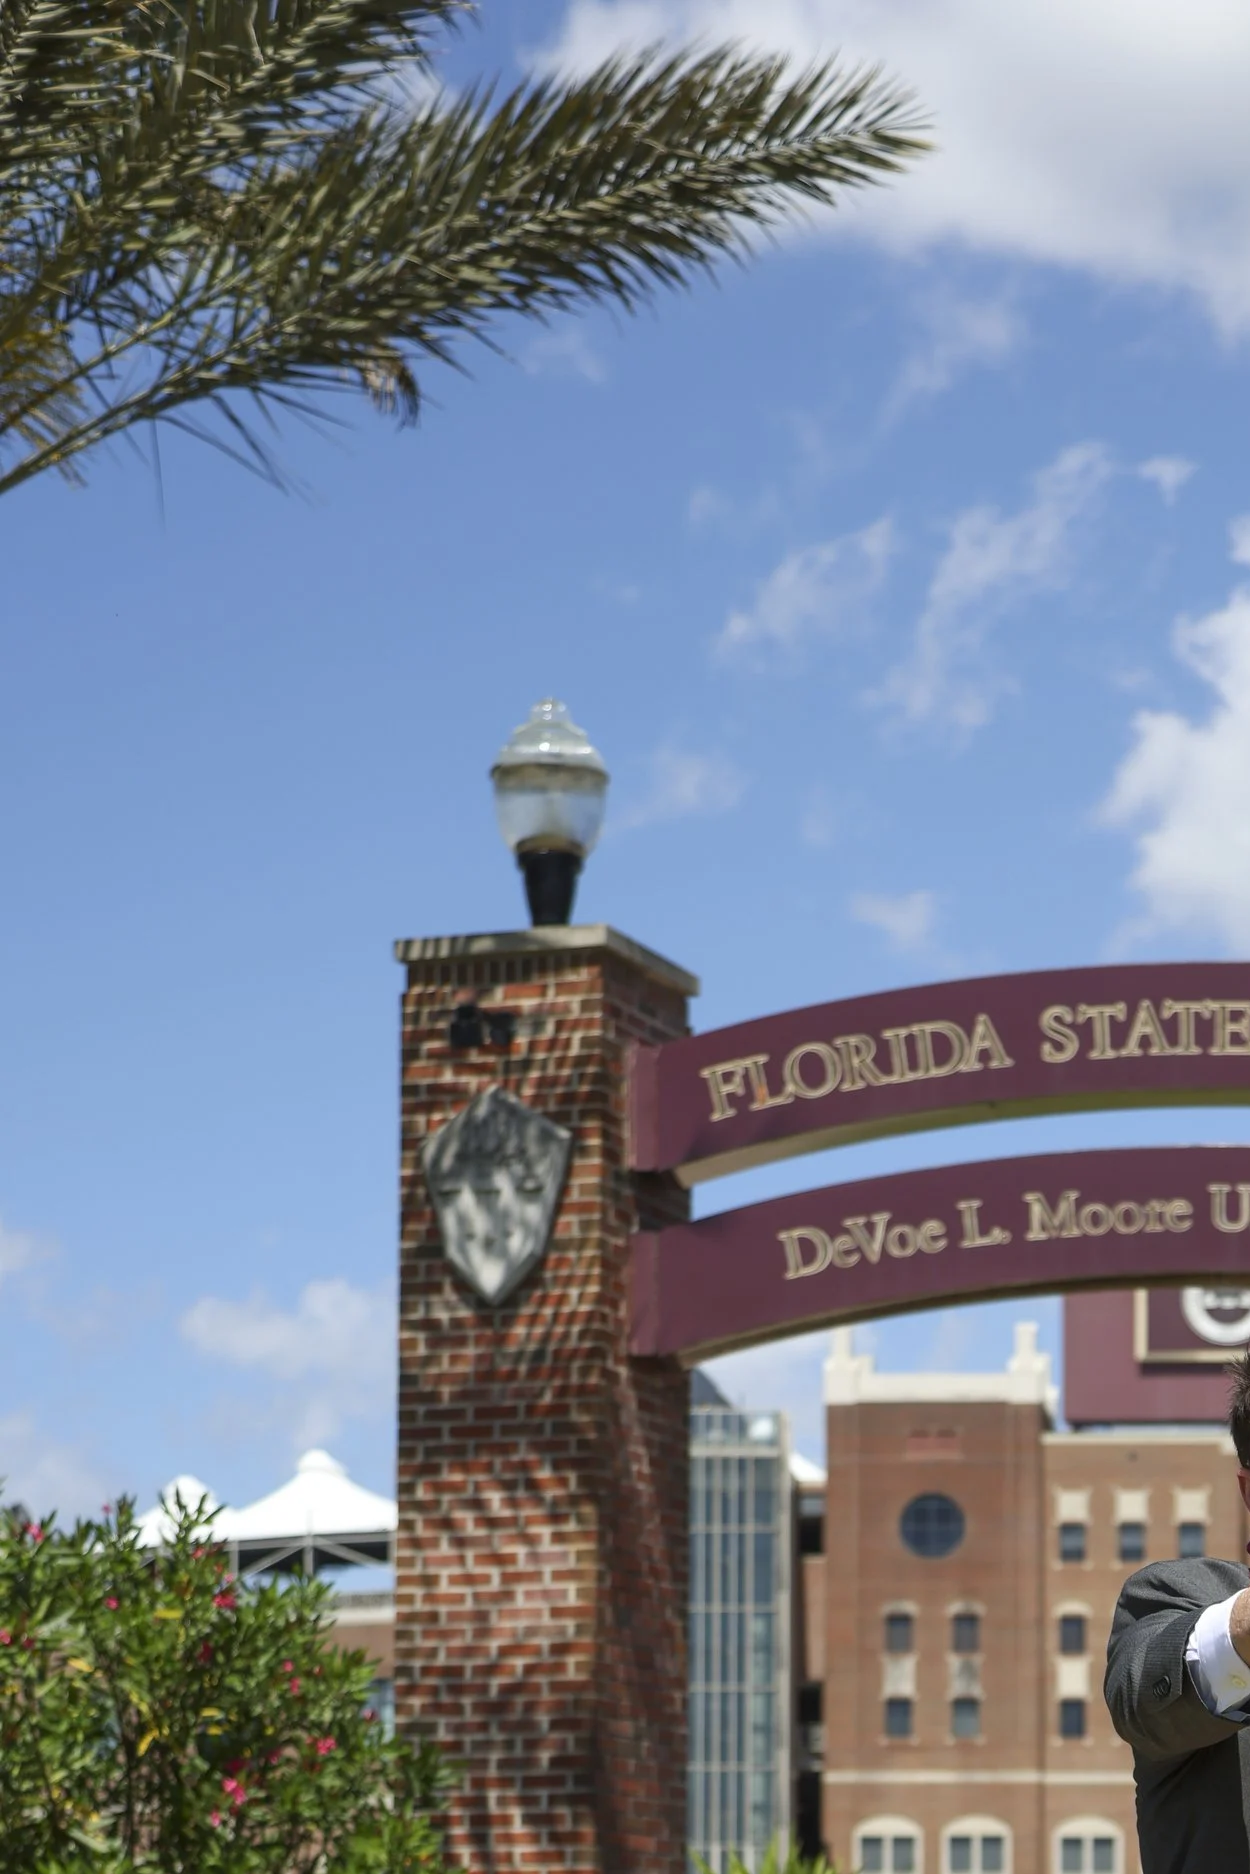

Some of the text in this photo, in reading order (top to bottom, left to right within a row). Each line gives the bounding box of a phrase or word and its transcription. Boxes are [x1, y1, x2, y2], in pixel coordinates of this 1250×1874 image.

[701, 1013, 1015, 1122] FLORIDA
[777, 1212, 949, 1280] DeVoe
[957, 1200, 1012, 1249] L.
[1024, 1189, 1195, 1242] Moore
